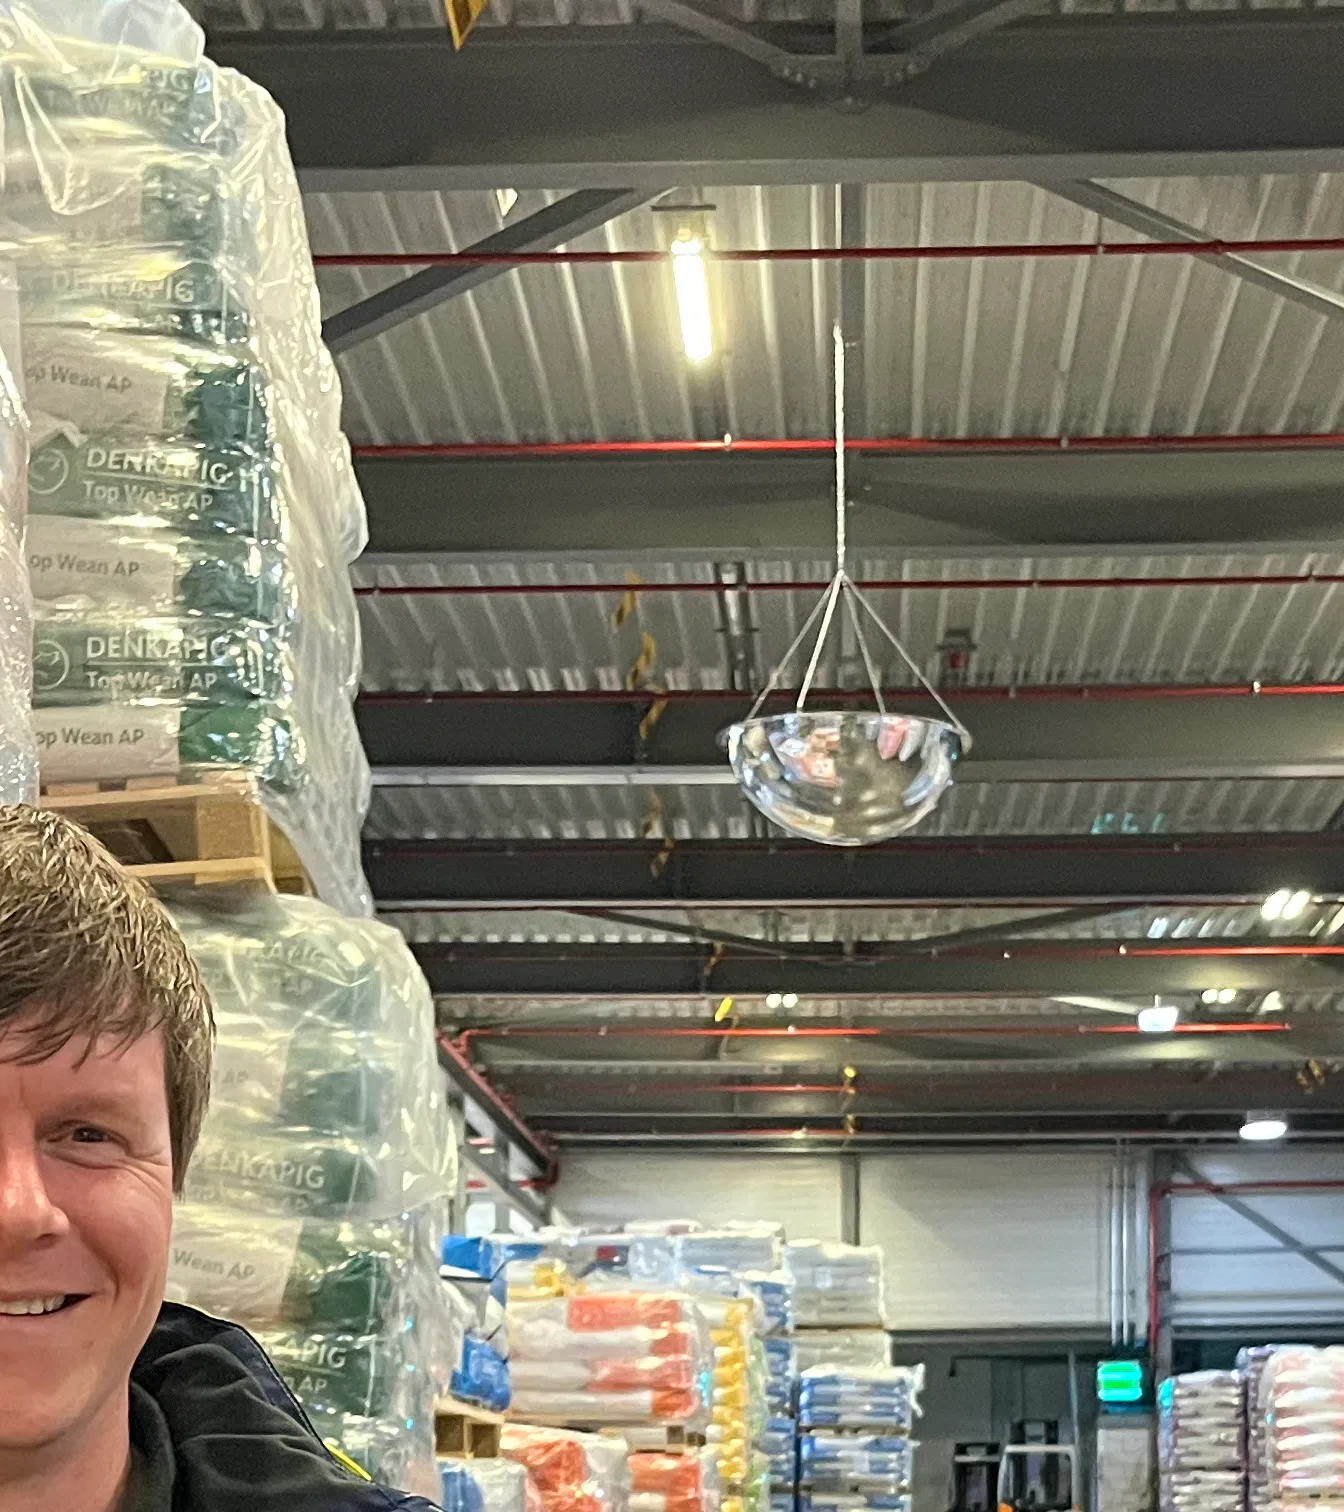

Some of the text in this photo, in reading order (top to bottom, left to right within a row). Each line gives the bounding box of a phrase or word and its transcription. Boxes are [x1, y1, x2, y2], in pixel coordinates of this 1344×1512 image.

[25, 368, 47, 383] op
[107, 375, 133, 394] AP
[183, 491, 214, 512] AP
[28, 553, 141, 577] op Wean AP
[190, 671, 218, 690] AP
[35, 729, 145, 747] op Wean AP
[227, 1261, 256, 1281] AP
